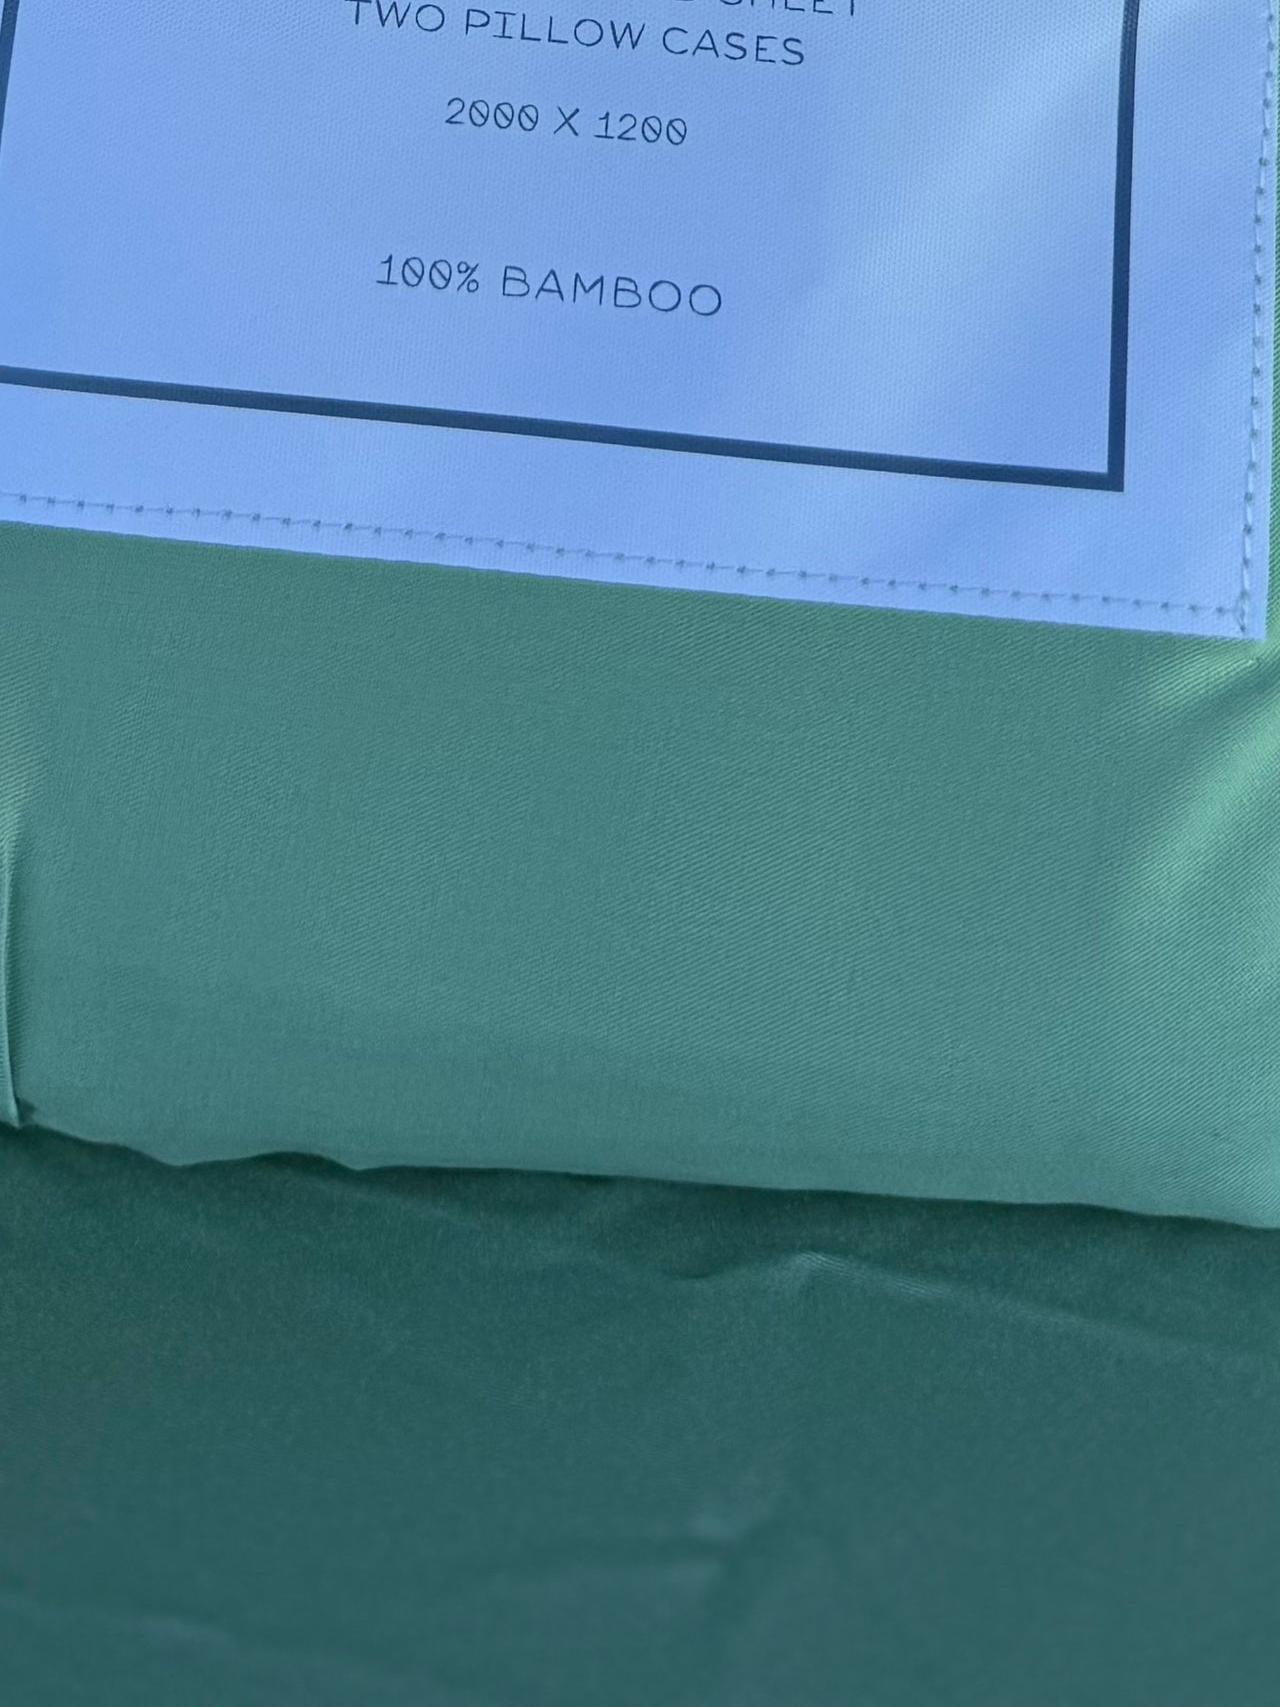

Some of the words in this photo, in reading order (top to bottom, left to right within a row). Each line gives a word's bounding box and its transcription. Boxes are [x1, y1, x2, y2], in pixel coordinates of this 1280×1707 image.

[465, 9, 646, 50] PILLOW
[662, 27, 805, 65] CASES
[445, 97, 540, 132] 2000
[553, 106, 580, 136] X
[594, 111, 688, 146] 1200
[376, 253, 480, 294] 100%
[502, 265, 723, 317] BAMBOO
